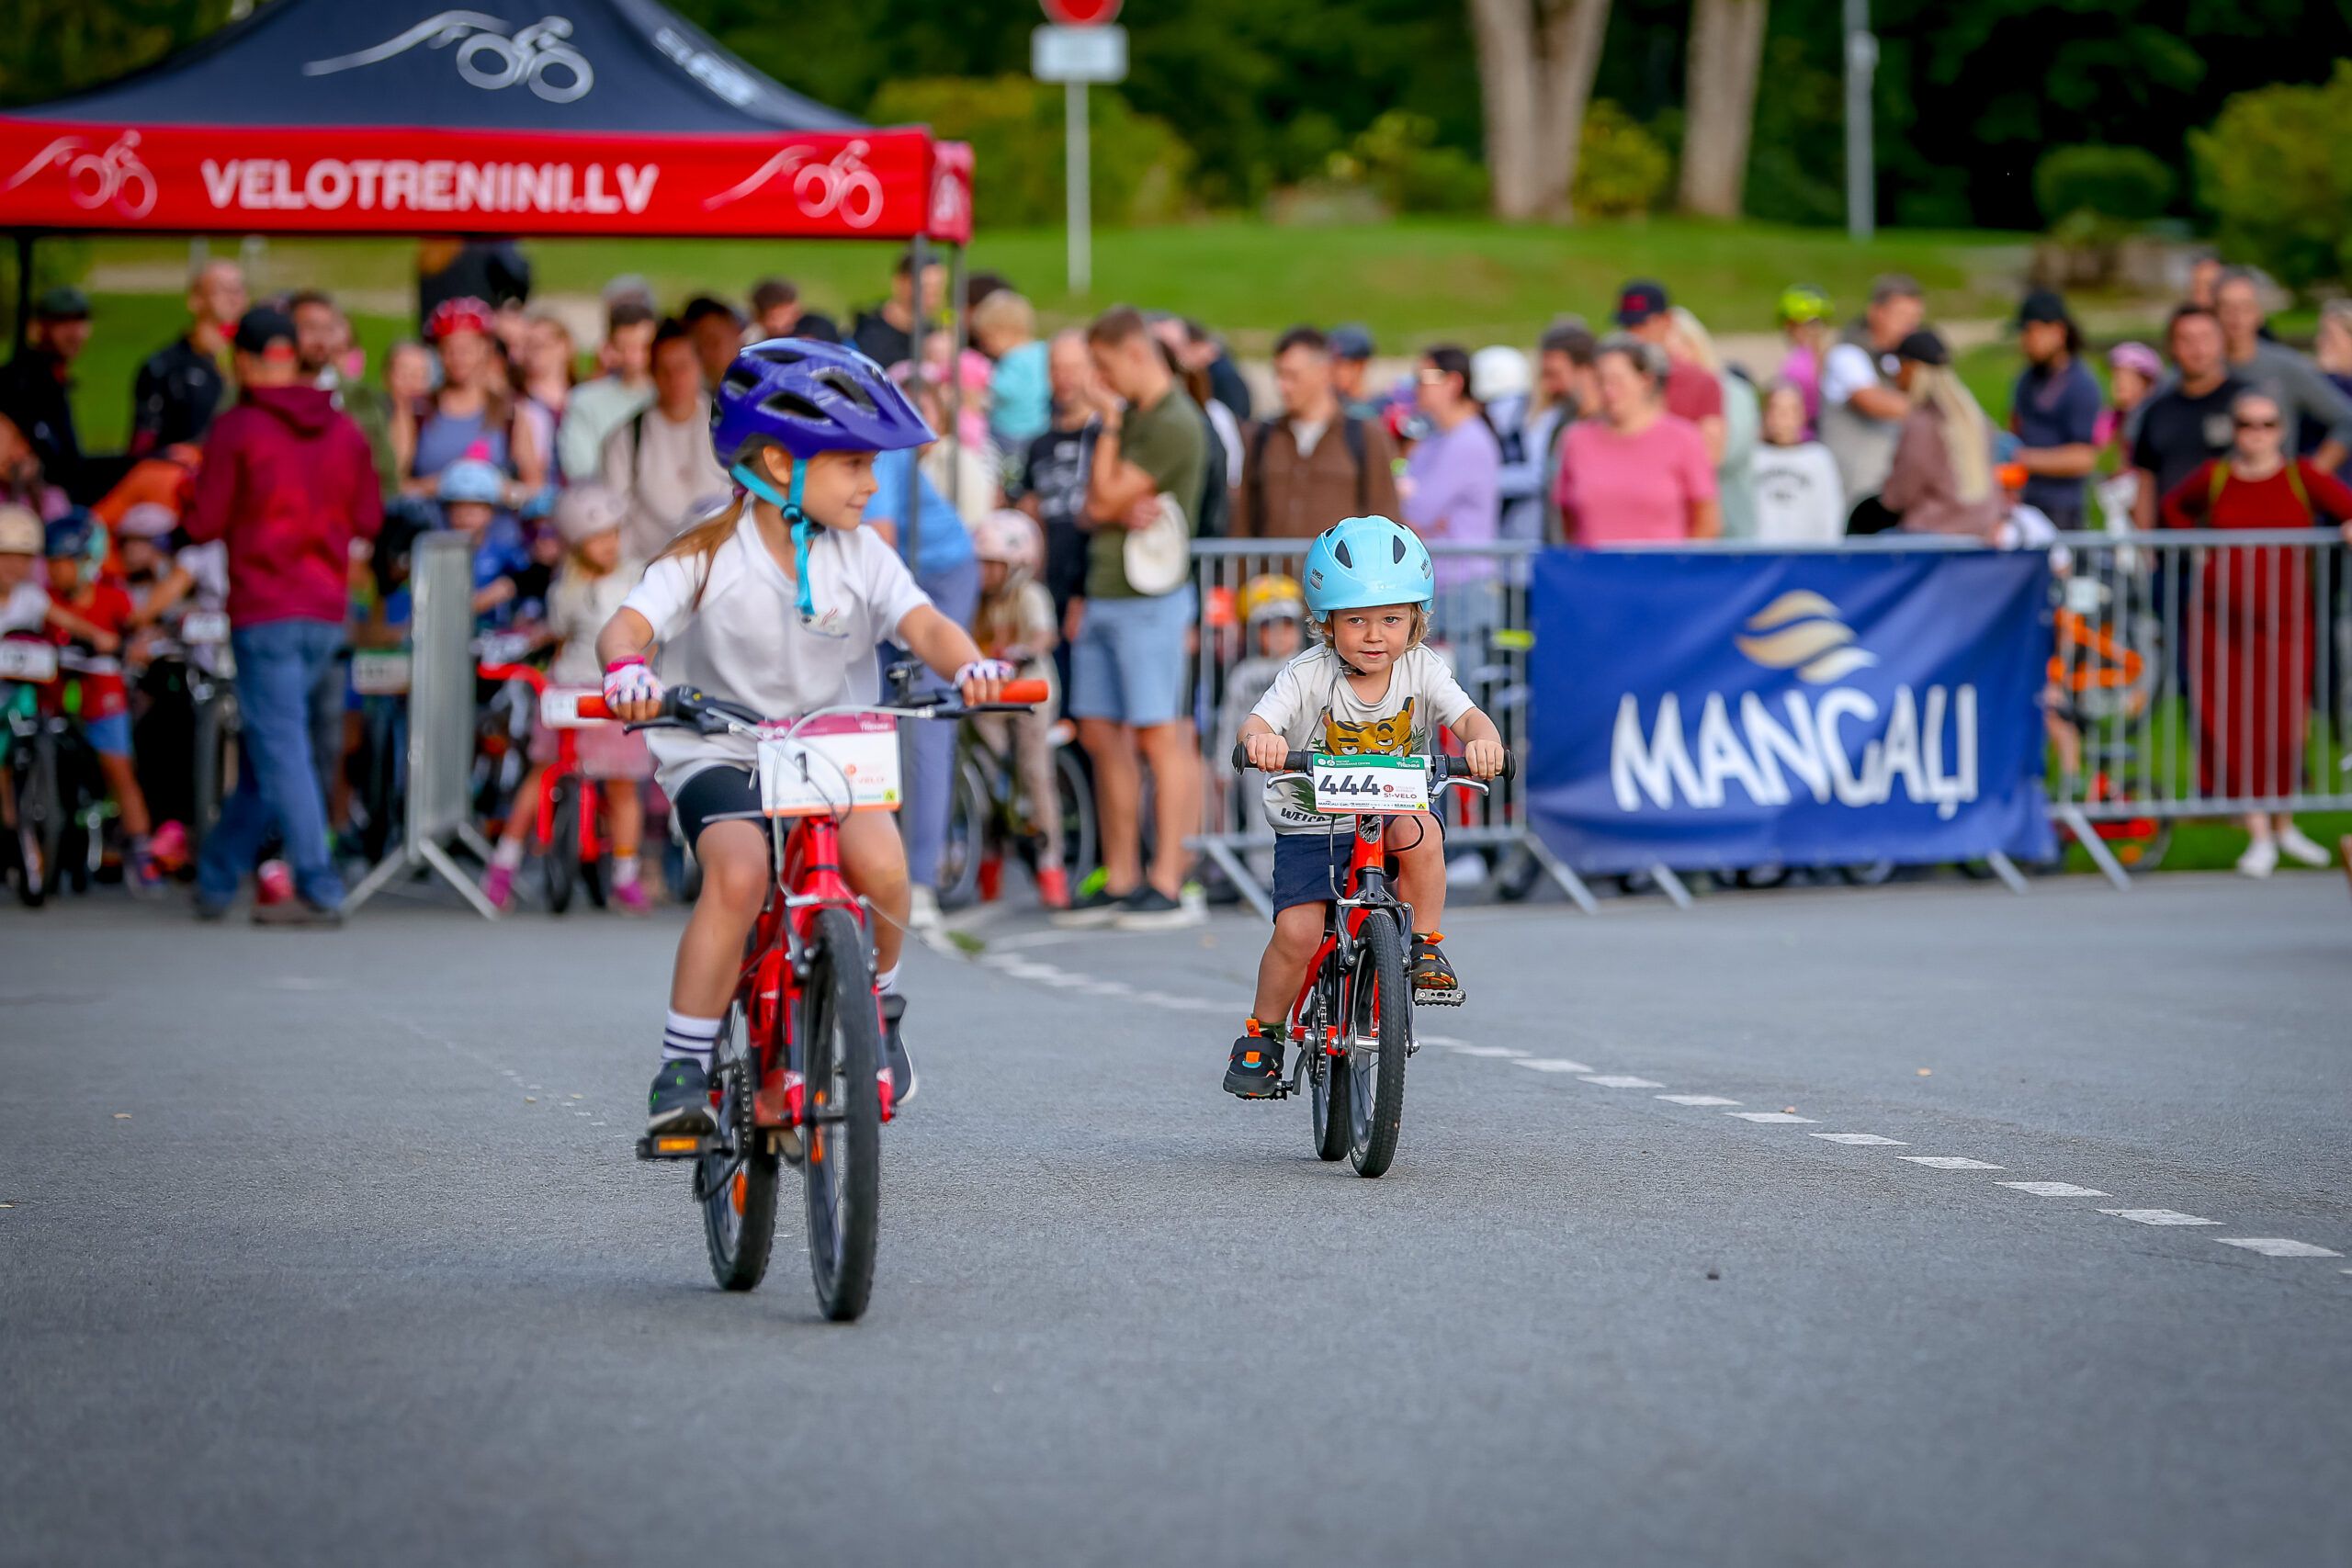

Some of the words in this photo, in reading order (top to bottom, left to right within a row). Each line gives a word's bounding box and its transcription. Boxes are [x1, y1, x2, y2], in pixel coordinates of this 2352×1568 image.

[201, 159, 659, 213] VELOTRENINI.LV
[1318, 775, 1380, 795] 444
[1281, 807, 1327, 823] WELCO
